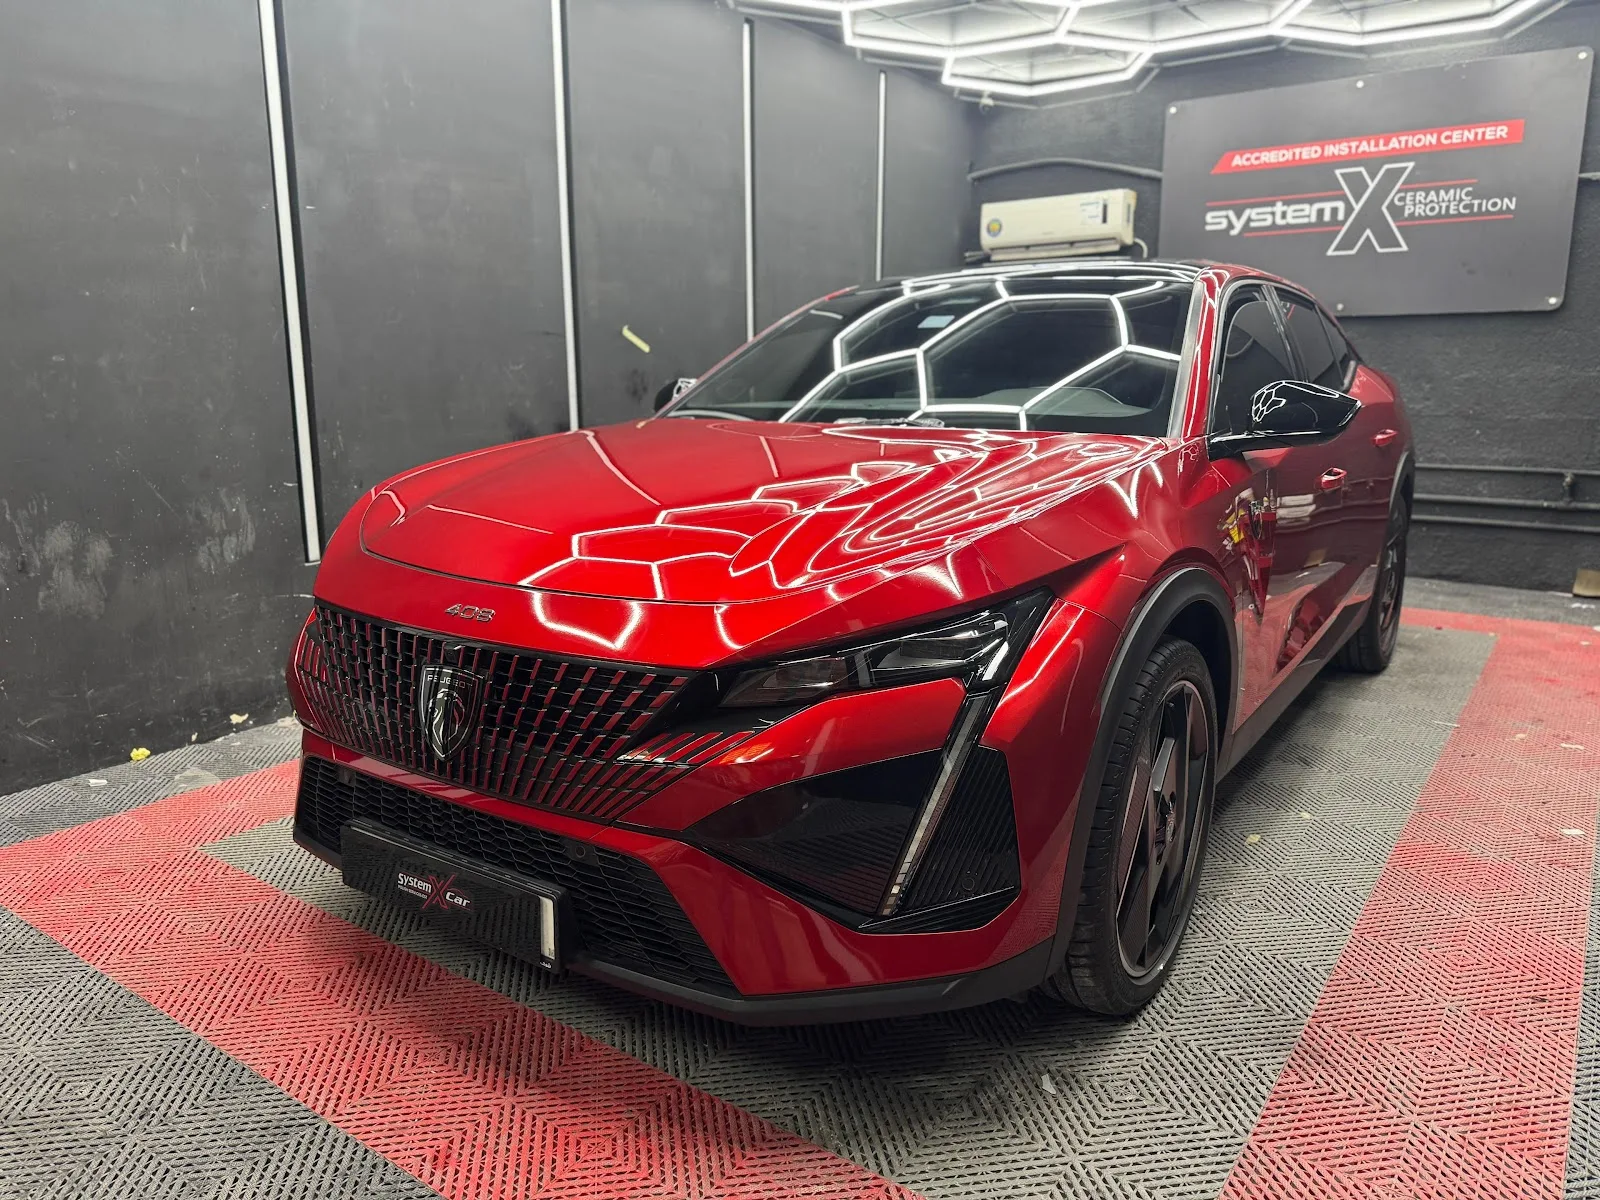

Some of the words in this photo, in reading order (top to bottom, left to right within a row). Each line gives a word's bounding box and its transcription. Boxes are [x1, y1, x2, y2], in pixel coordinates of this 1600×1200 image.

[1232, 146, 1322, 167] ACCREDITED
[1324, 133, 1438, 158] INSTALLATION
[1440, 125, 1508, 144] CENTER
[1394, 187, 1473, 205] CERAMIC
[1405, 197, 1516, 218] PROTECTION
[445, 604, 496, 622] 408
[427, 674, 473, 689] PEUGEOT
[397, 872, 432, 893] System
[445, 891, 471, 907] Car
